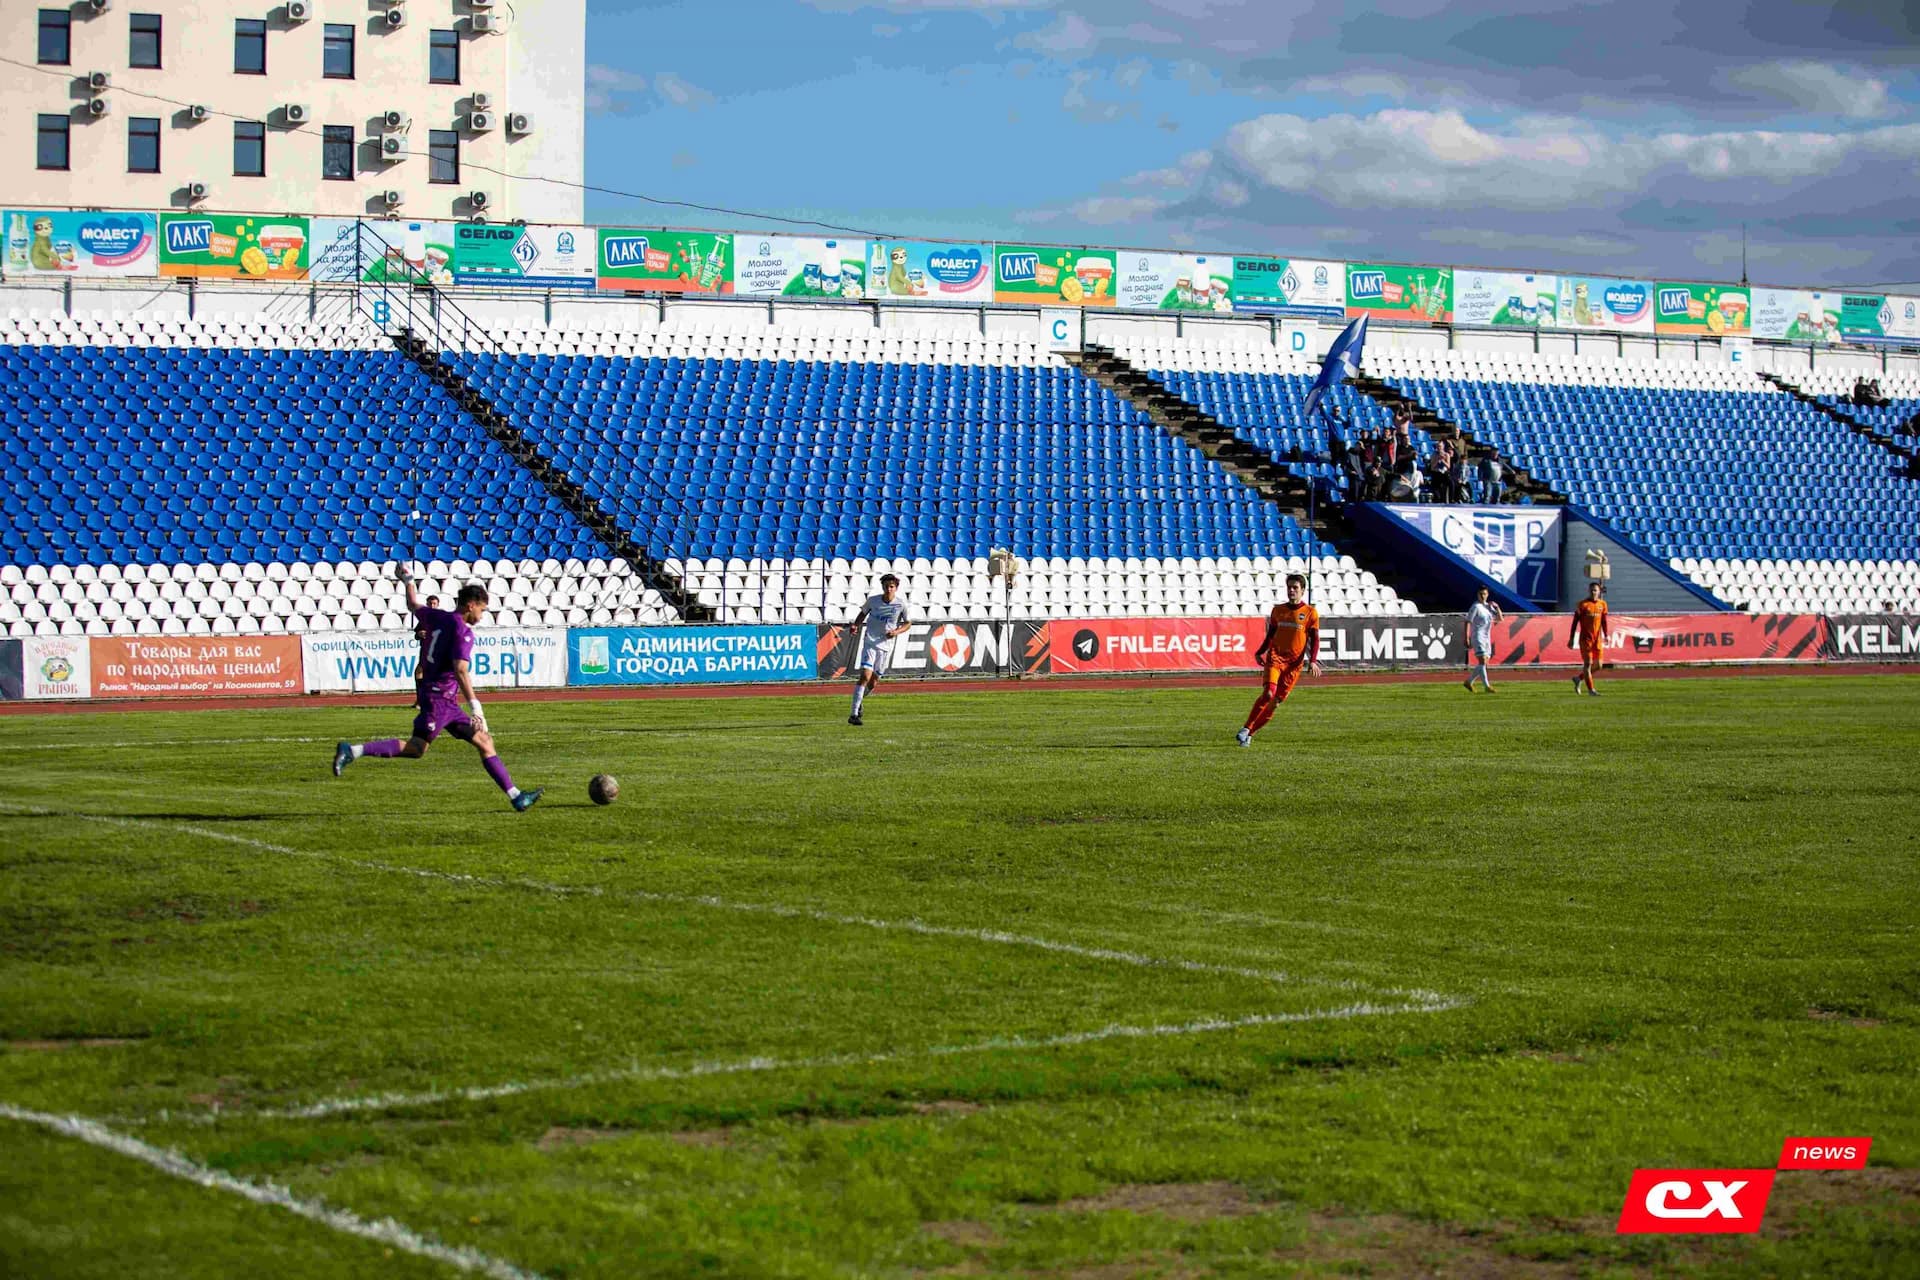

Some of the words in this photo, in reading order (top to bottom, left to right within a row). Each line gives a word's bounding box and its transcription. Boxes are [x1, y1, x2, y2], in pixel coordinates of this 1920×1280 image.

[82, 228, 140, 241] МОДЕСТ
[173, 225, 211, 247] ЛАКТ
[460, 228, 515, 240] СЕЛФ
[324, 244, 361, 253] Молок
[611, 241, 646, 262] ЛАКТ
[748, 259, 782, 268] Молоко
[931, 257, 979, 270] МОДЕСТ
[1005, 257, 1037, 277] ЛАКТ
[1237, 261, 1280, 272] СЕЛФ
[741, 270, 753, 278] на
[755, 269, 788, 279] разные
[1129, 274, 1159, 282] Молоко
[1355, 275, 1383, 294] ЛАКТ
[1606, 291, 1644, 304] МОДЕСТ
[1663, 292, 1688, 311] ЛАКТ
[1844, 297, 1879, 307] СЕЛФ
[1292, 332, 1305, 350] D
[1528, 561, 1545, 596] 7
[312, 638, 405, 653] ОФИЦИАЛЬНЫЙ
[426, 628, 442, 664] 1
[621, 634, 802, 656] АДМИНИСТРАЦИЯ
[1106, 634, 1246, 654] FNLEAGUE2
[1304, 628, 1419, 660] ELME
[1662, 632, 1719, 648] ЛИГА
[1721, 632, 1735, 647] Б
[126, 642, 191, 663] Товары
[198, 646, 228, 662] для
[234, 645, 262, 657] вас
[107, 664, 126, 676] по
[132, 663, 217, 680] народным
[223, 656, 281, 678] ценам!
[616, 656, 699, 676] ГОРОДА
[705, 654, 808, 673] БАРНАУЛА
[100, 682, 128, 692] Рынок
[225, 681, 283, 690] Космонавтов,
[285, 680, 296, 688] 59
